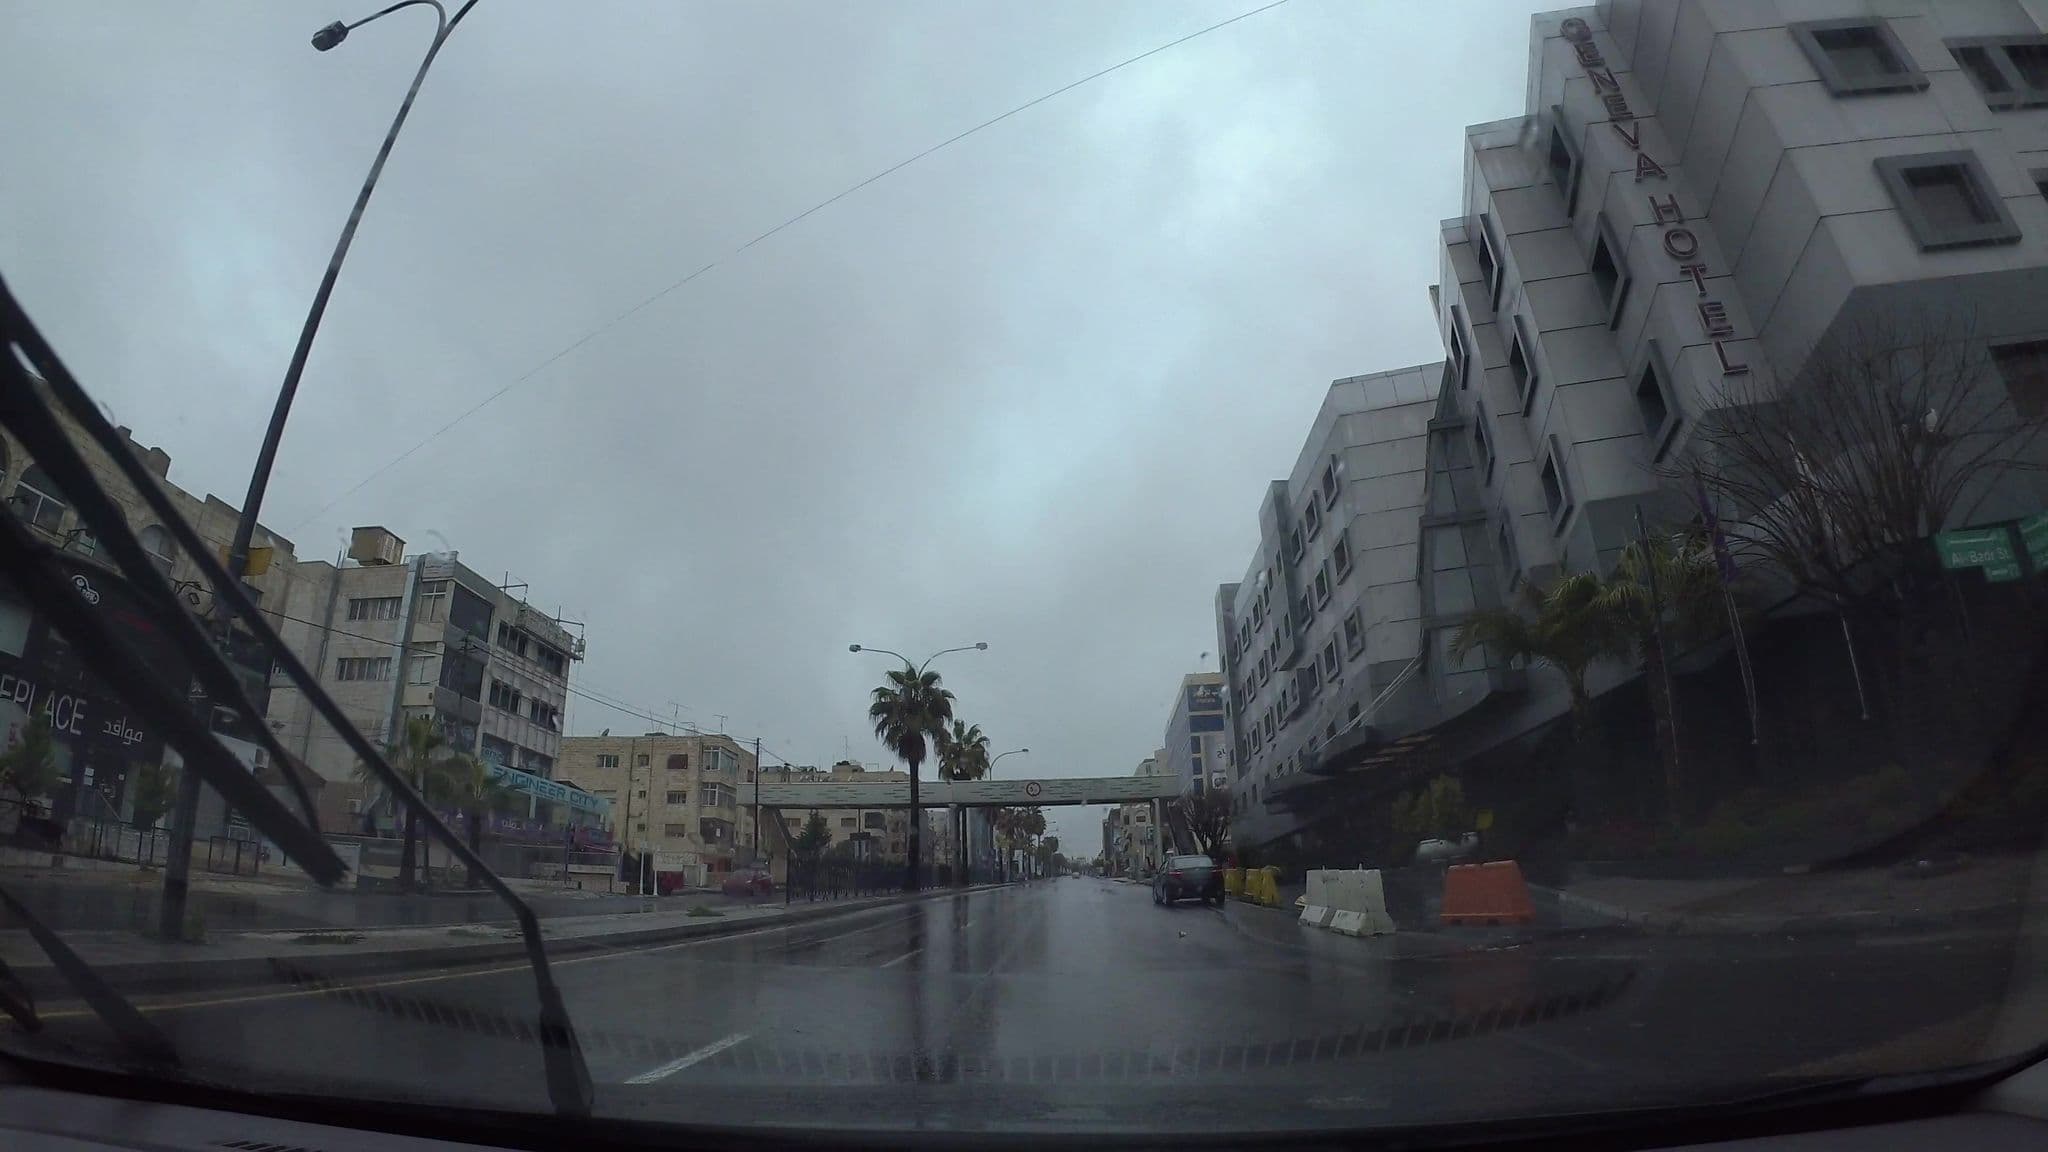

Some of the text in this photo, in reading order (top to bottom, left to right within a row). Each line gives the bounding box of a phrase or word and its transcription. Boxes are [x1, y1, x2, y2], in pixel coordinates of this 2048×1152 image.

[1560, 17, 1749, 376] GENEVA HOTEL
[570, 791, 599, 807] CITY
